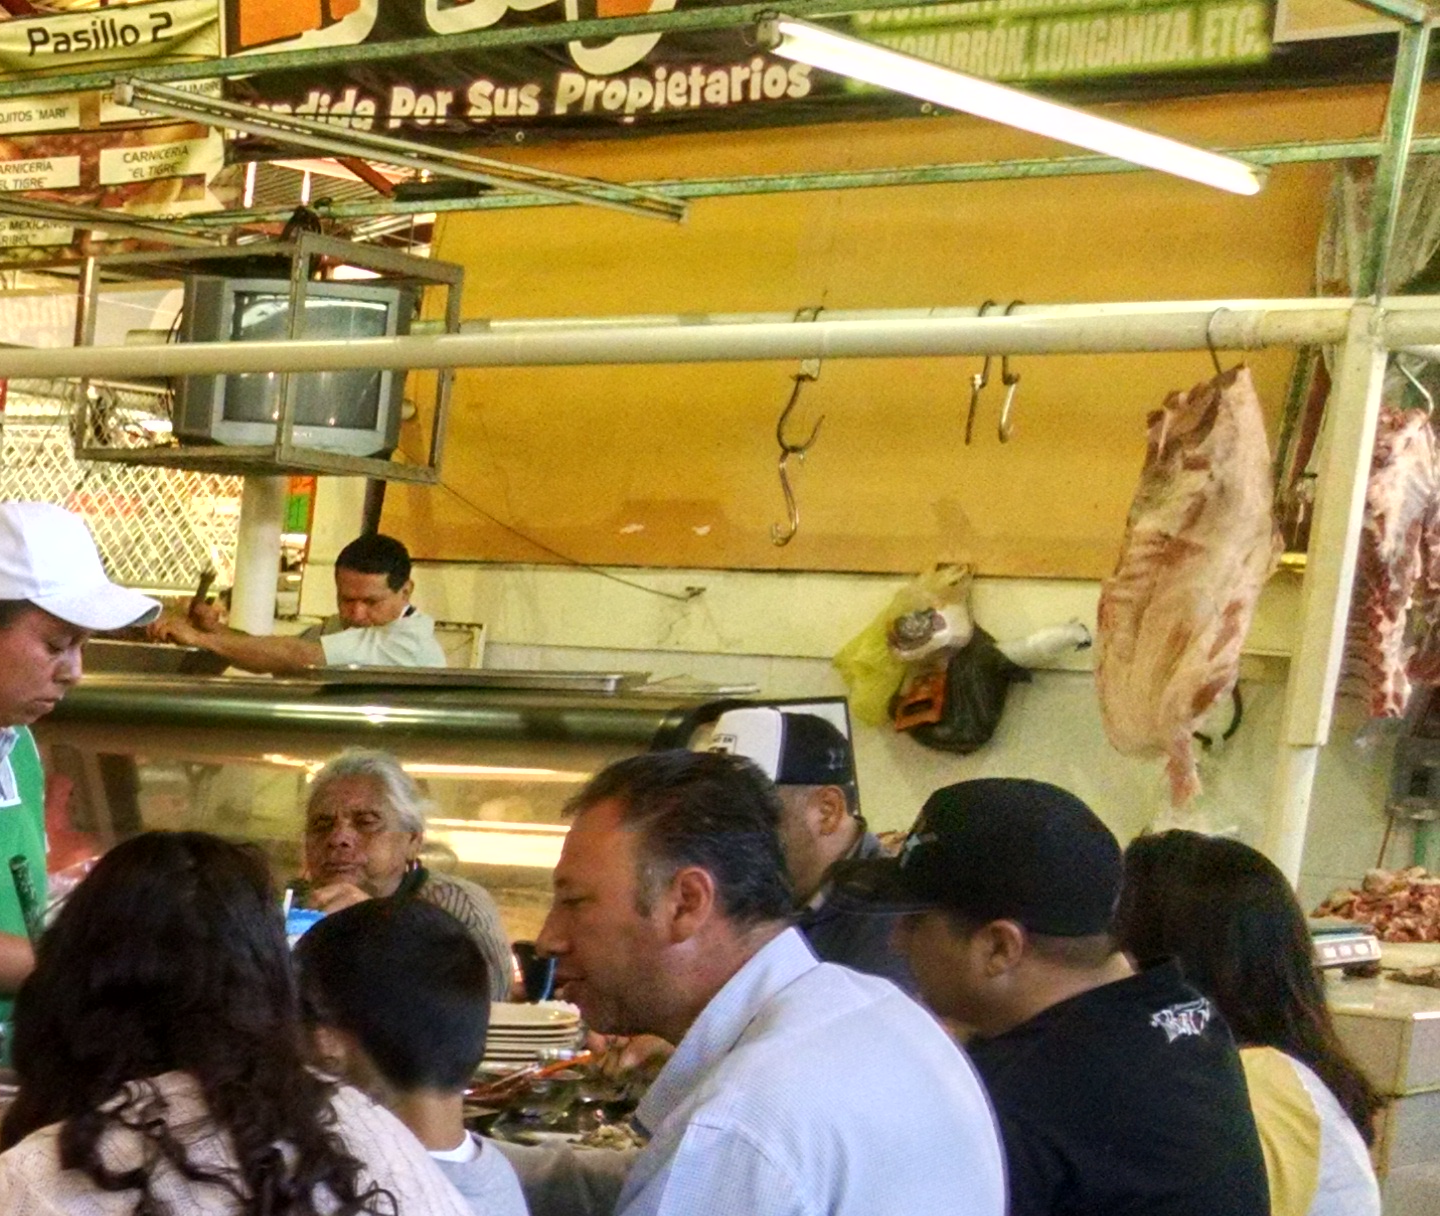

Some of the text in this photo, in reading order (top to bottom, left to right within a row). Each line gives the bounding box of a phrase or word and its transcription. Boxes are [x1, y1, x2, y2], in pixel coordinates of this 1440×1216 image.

[26, 11, 173, 56] Pasillo 2
[389, 86, 452, 128] Por
[468, 80, 540, 122] Sus
